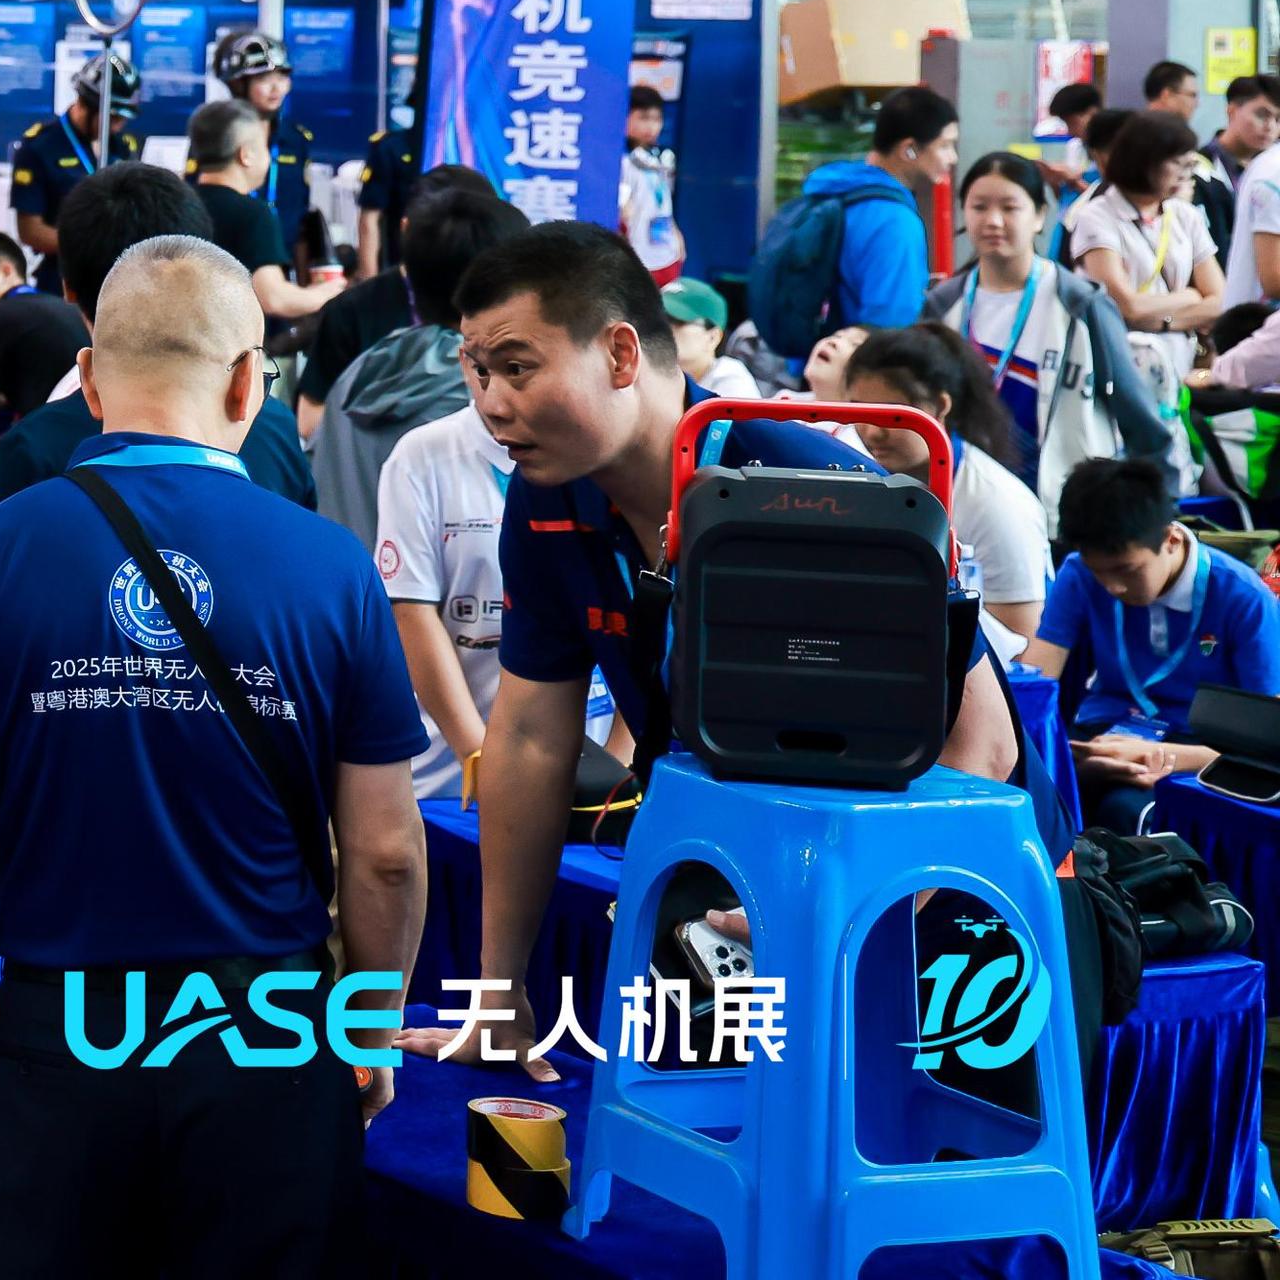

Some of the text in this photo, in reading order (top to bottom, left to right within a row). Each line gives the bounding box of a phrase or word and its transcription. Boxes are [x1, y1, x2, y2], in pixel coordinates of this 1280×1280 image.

[113, 598, 135, 633] DRONE
[135, 630, 170, 647] WORLD
[50, 655, 276, 688] 2025年世界无人大会
